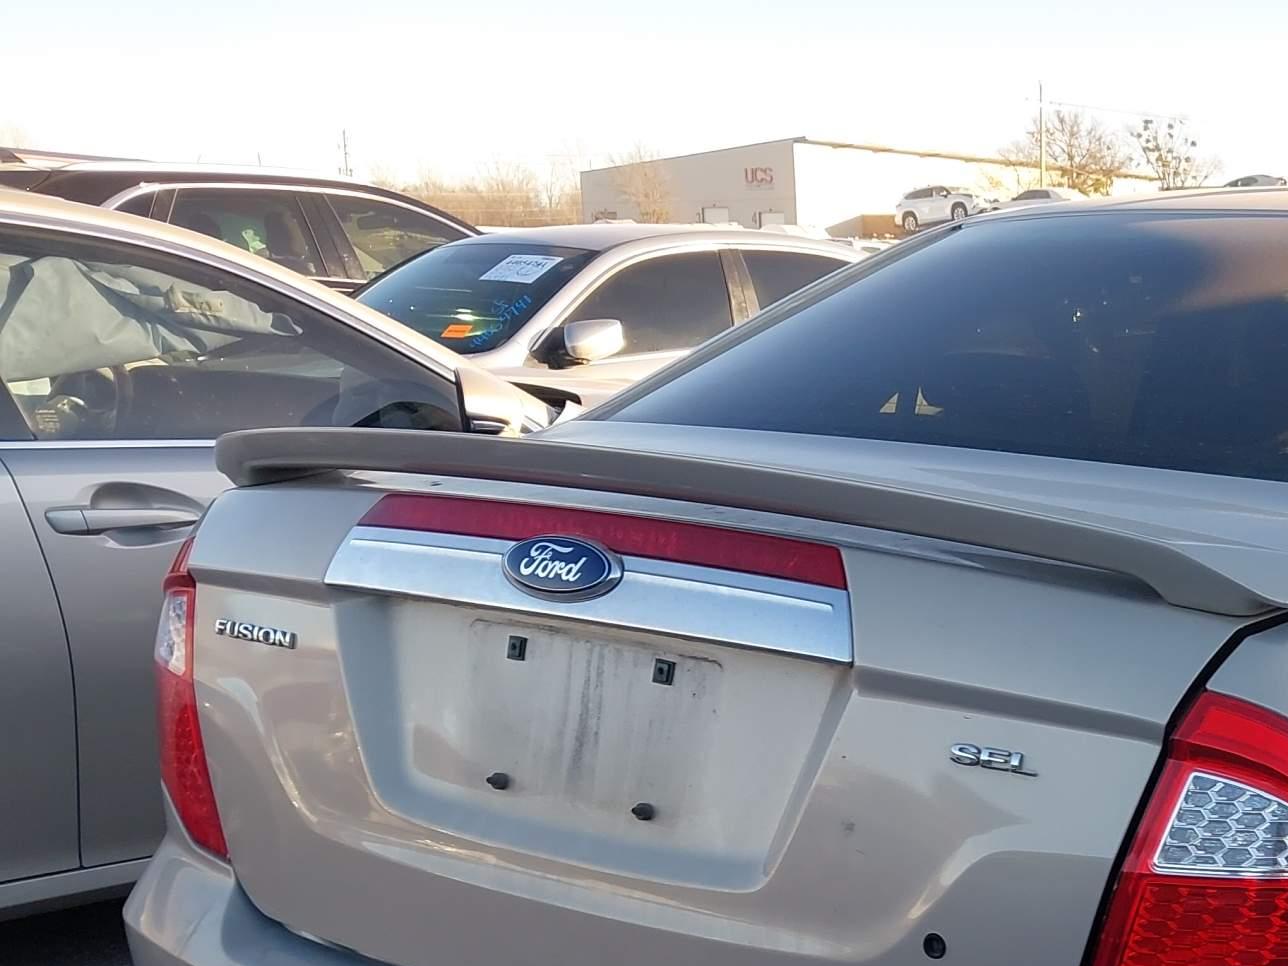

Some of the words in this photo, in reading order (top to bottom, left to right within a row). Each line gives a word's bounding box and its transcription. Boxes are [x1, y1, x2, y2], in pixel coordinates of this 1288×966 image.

[744, 167, 774, 184] UCS
[520, 542, 587, 582] Ford
[215, 619, 298, 649] FUSION
[950, 743, 1038, 777] SEL
